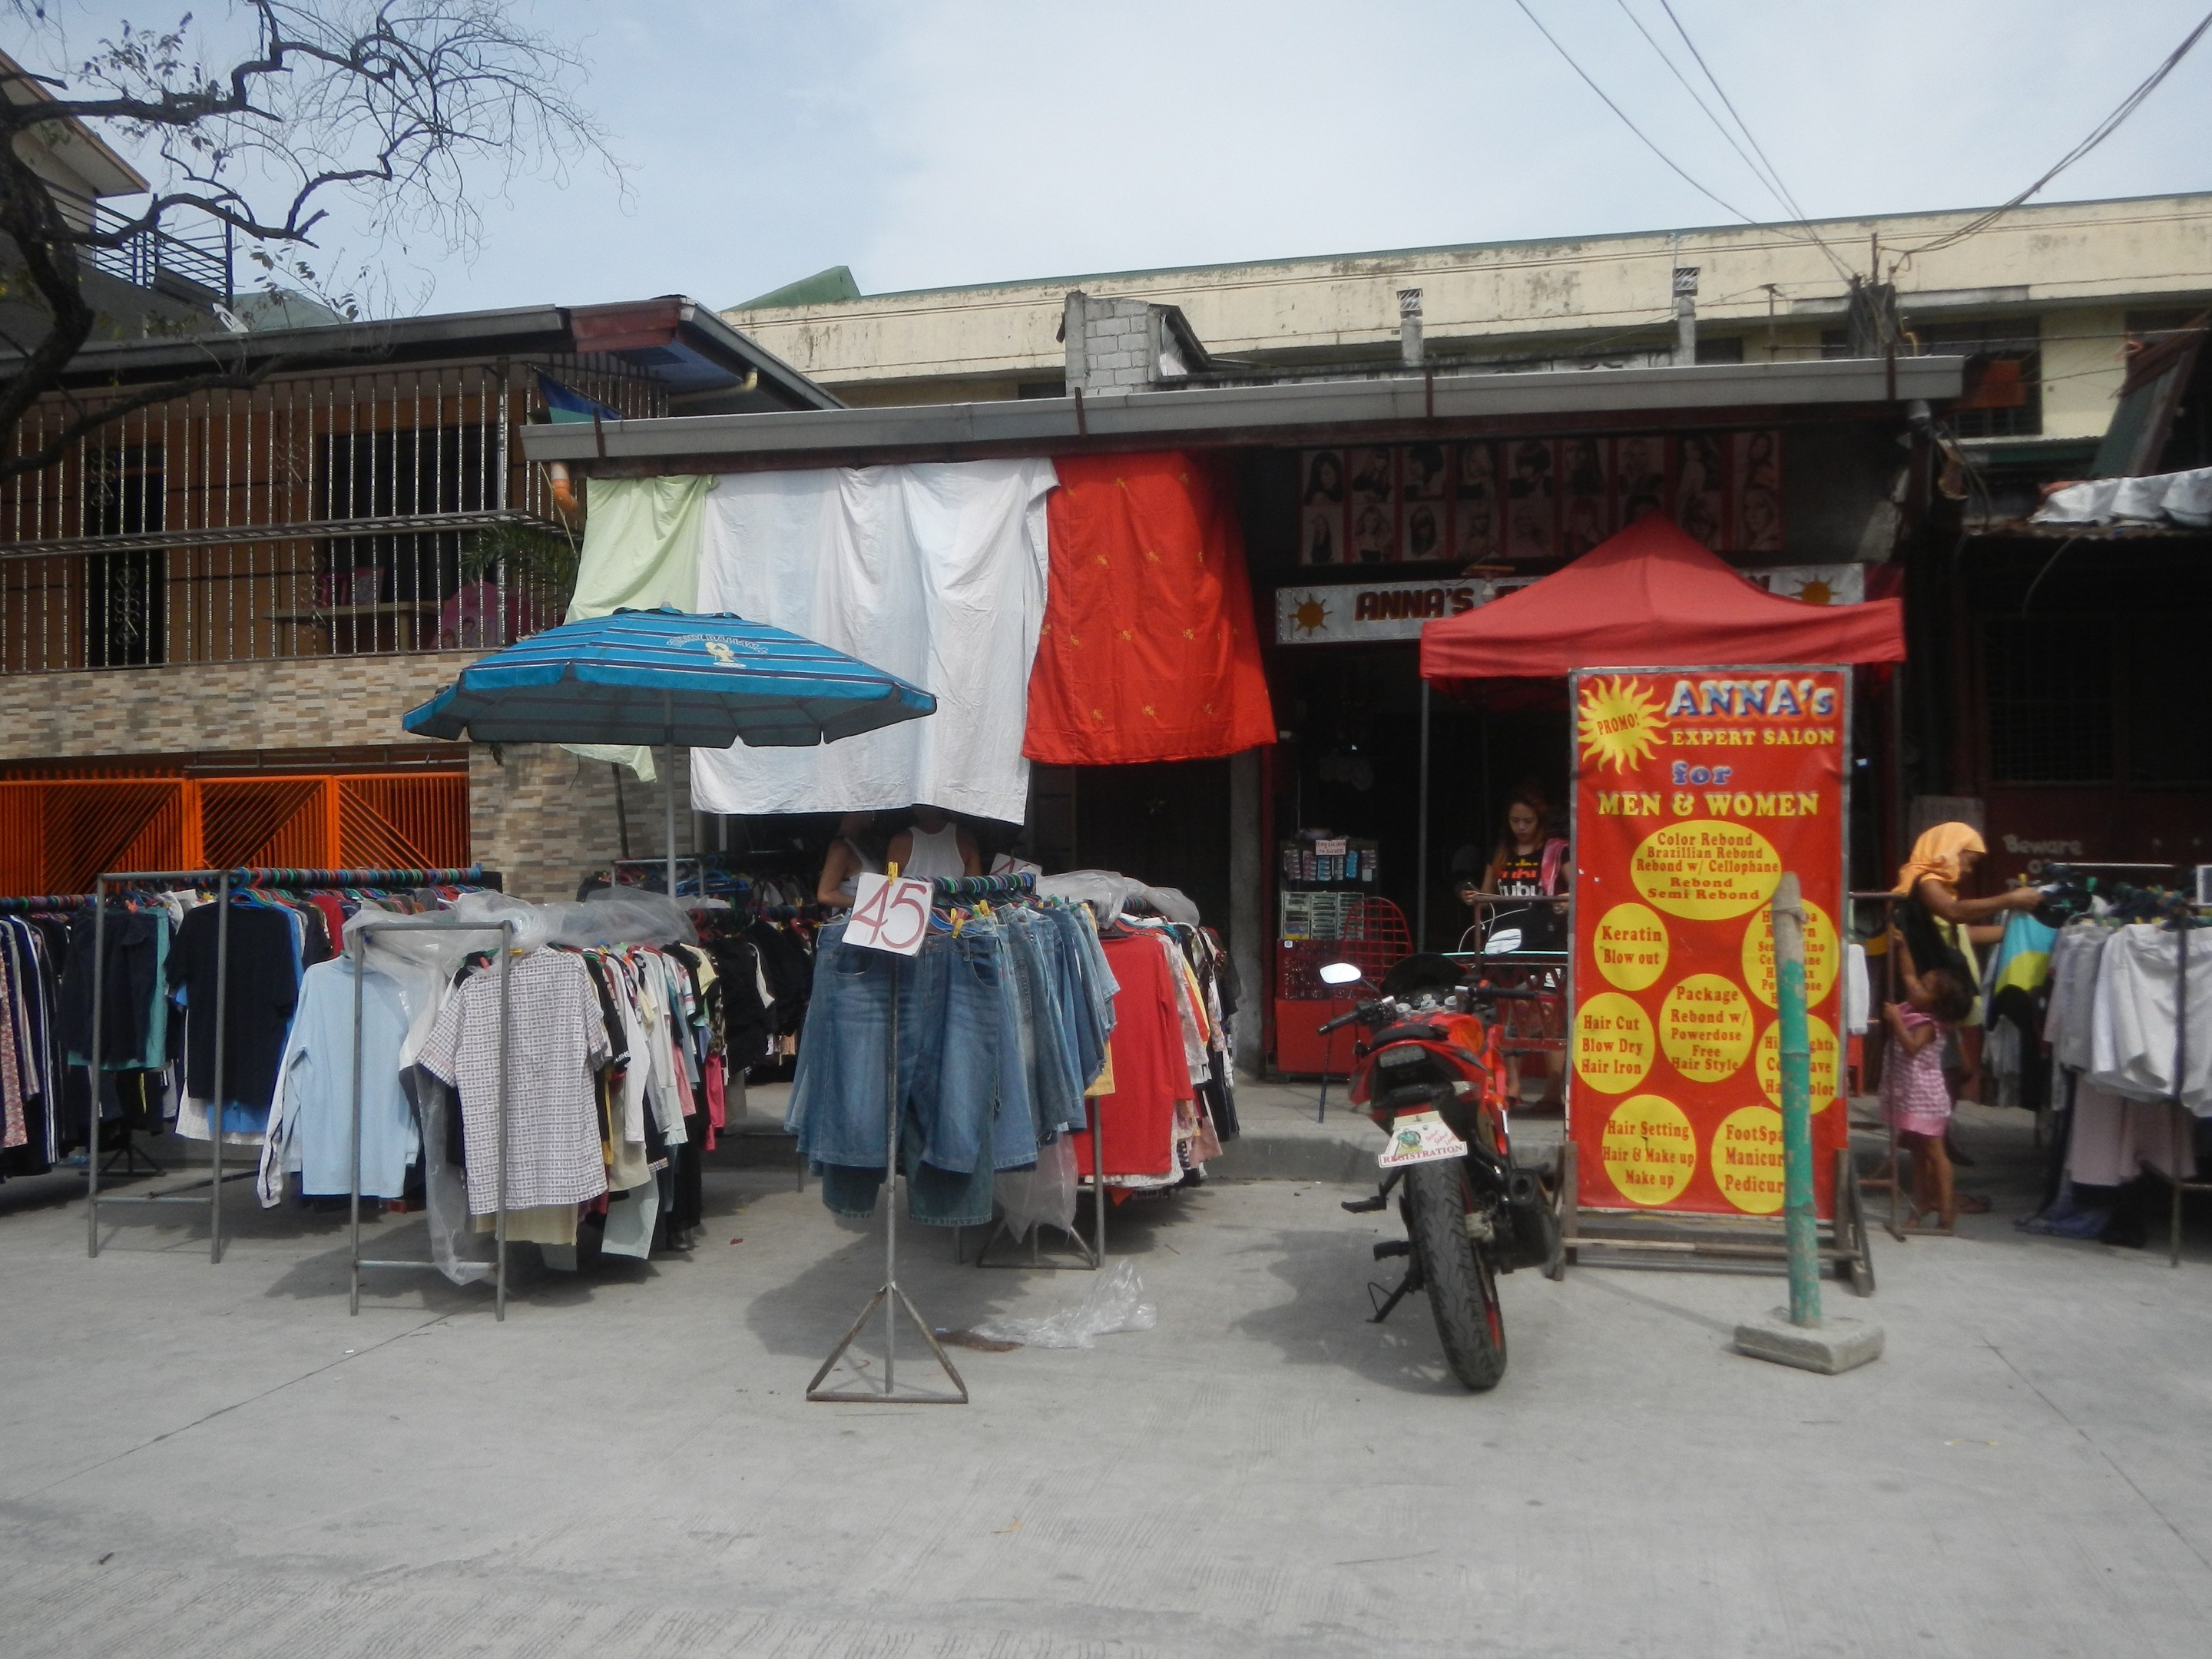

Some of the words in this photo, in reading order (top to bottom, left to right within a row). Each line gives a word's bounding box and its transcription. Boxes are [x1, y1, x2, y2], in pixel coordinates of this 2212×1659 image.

[1355, 586, 1475, 621] ANNA'S
[1596, 713, 1640, 736] PROMO!
[1671, 729, 1756, 747] EXPERT
[1763, 729, 1835, 746] SALON
[1671, 760, 1732, 786] for
[1597, 791, 1661, 816] MEN
[1671, 791, 1694, 816] &
[1704, 792, 1820, 816] WOMEN
[1657, 832, 1696, 846] Color
[1700, 832, 1753, 846] Rebond
[1647, 846, 1712, 859] Brazillian
[1717, 846, 1763, 859] Rebond
[1636, 859, 1682, 873] Rebond
[1687, 859, 1704, 874] w/
[1708, 859, 1778, 876] Cellophane
[1670, 876, 1733, 888] Rebond
[1647, 888, 1689, 899] Semi
[1695, 889, 1760, 900] Rebond
[850, 879, 928, 949] 45
[1601, 925, 1662, 942] Keratin
[1603, 949, 1634, 965] Blow
[1638, 952, 1660, 965] out
[1676, 985, 1739, 1005] Package
[1583, 1015, 1611, 1030] Hair
[1616, 1015, 1640, 1031] Cut
[1670, 1008, 1724, 1023] Rebond
[1729, 1010, 1748, 1027] w/
[1670, 1027, 1742, 1041] Powerdose
[1582, 1038, 1614, 1053] Blow
[1618, 1038, 1643, 1056] Dry
[1692, 1045, 1721, 1058] Free
[1581, 1058, 1609, 1074] Hair
[1613, 1058, 1641, 1075] Iron
[1671, 1057, 1700, 1071] Hair
[1704, 1058, 1739, 1072] Style
[1606, 1120, 1636, 1135] Hair
[1641, 1120, 1690, 1141] Setting
[1602, 1146, 1628, 1161] Hair
[1632, 1147, 1642, 1162] &
[1645, 1147, 1676, 1164] Make
[1679, 1152, 1695, 1167] up
[1725, 1147, 1784, 1167] Manicur
[1624, 1170, 1656, 1186] Make
[1659, 1174, 1674, 1189] up
[1724, 1174, 1784, 1194] Pedicur
